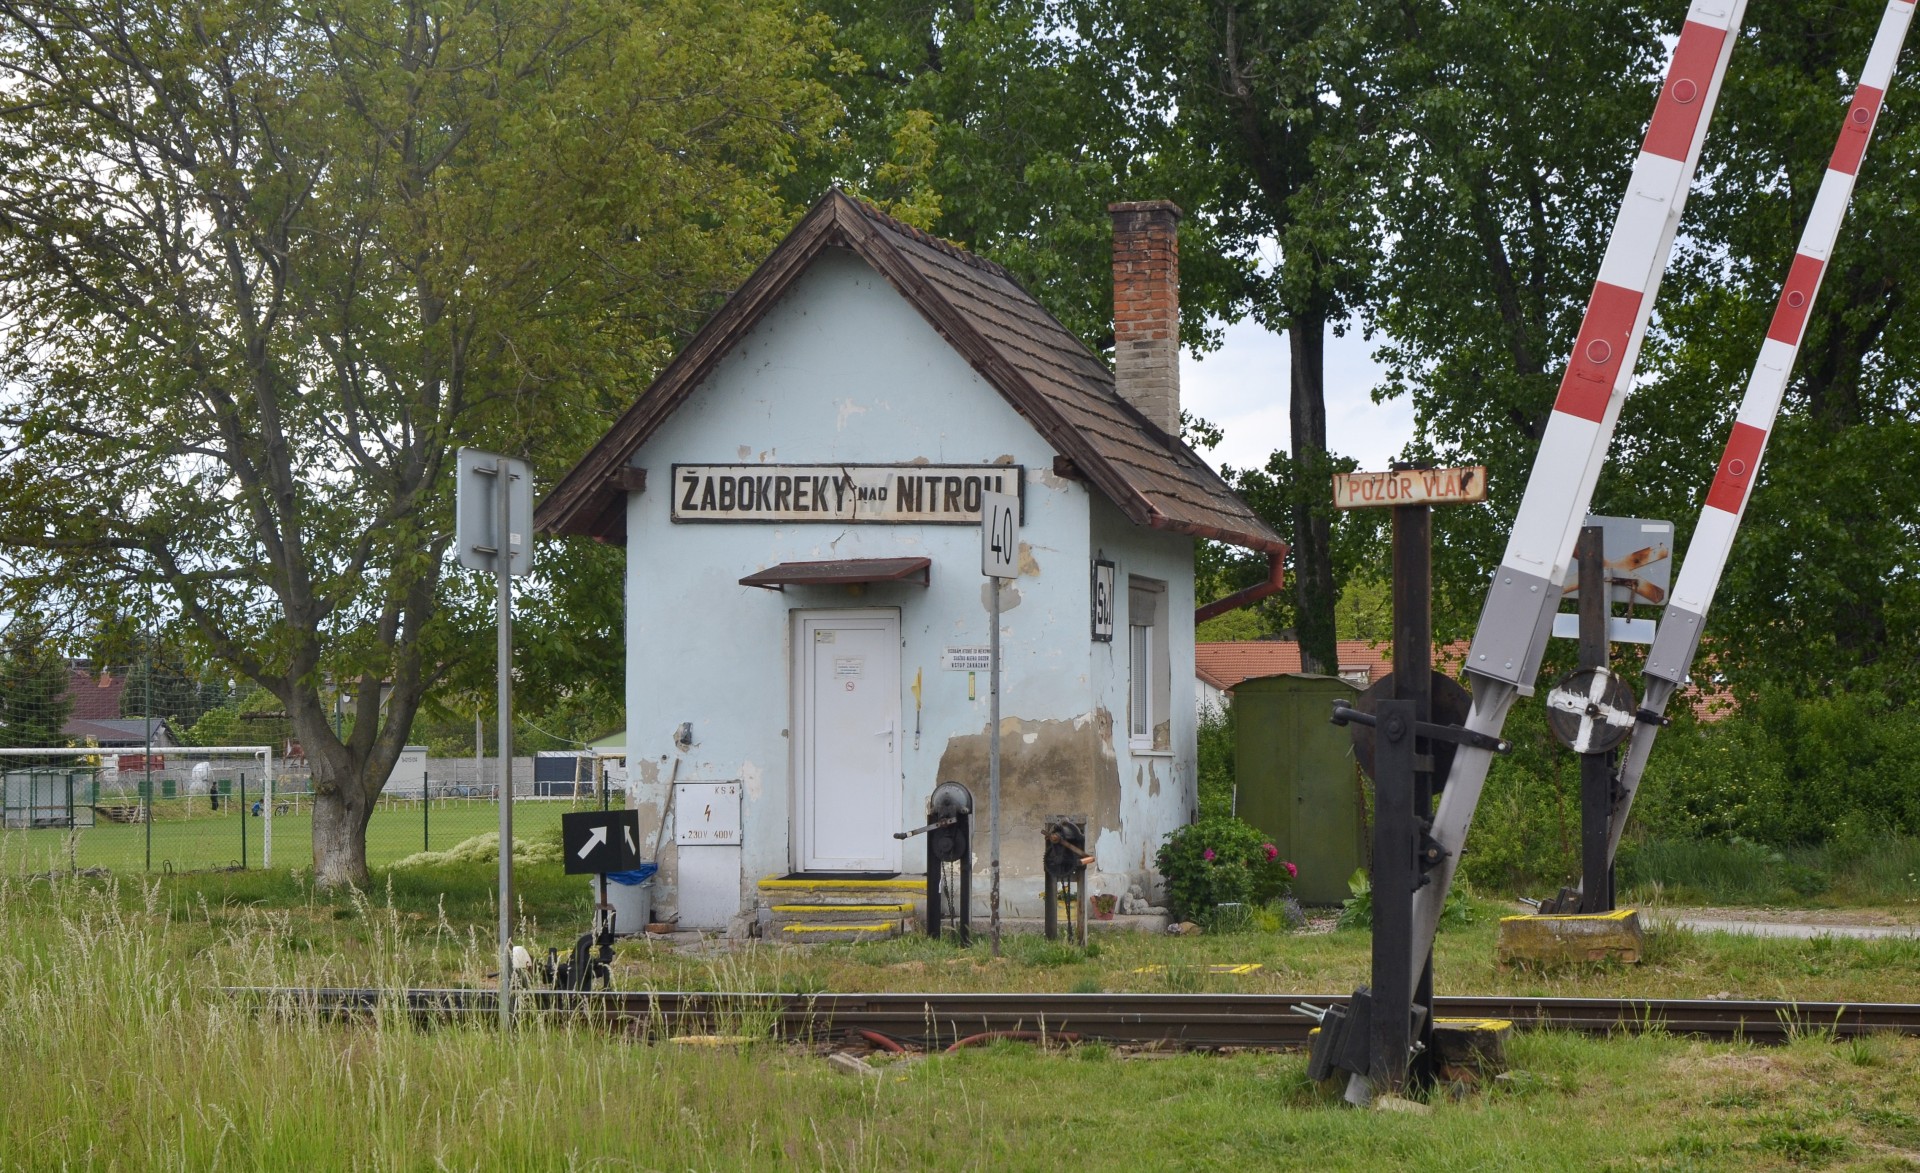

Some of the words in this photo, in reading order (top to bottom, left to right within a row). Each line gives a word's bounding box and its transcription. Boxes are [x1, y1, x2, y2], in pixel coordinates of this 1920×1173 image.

[681, 469, 847, 512] ŽABOKREKY
[858, 486, 888, 501] NAD
[1348, 477, 1414, 503] POZOR
[1423, 473, 1474, 498] VLAK
[991, 504, 1012, 565] 40
[688, 830, 708, 839] 230V
[713, 830, 733, 839] 400V
